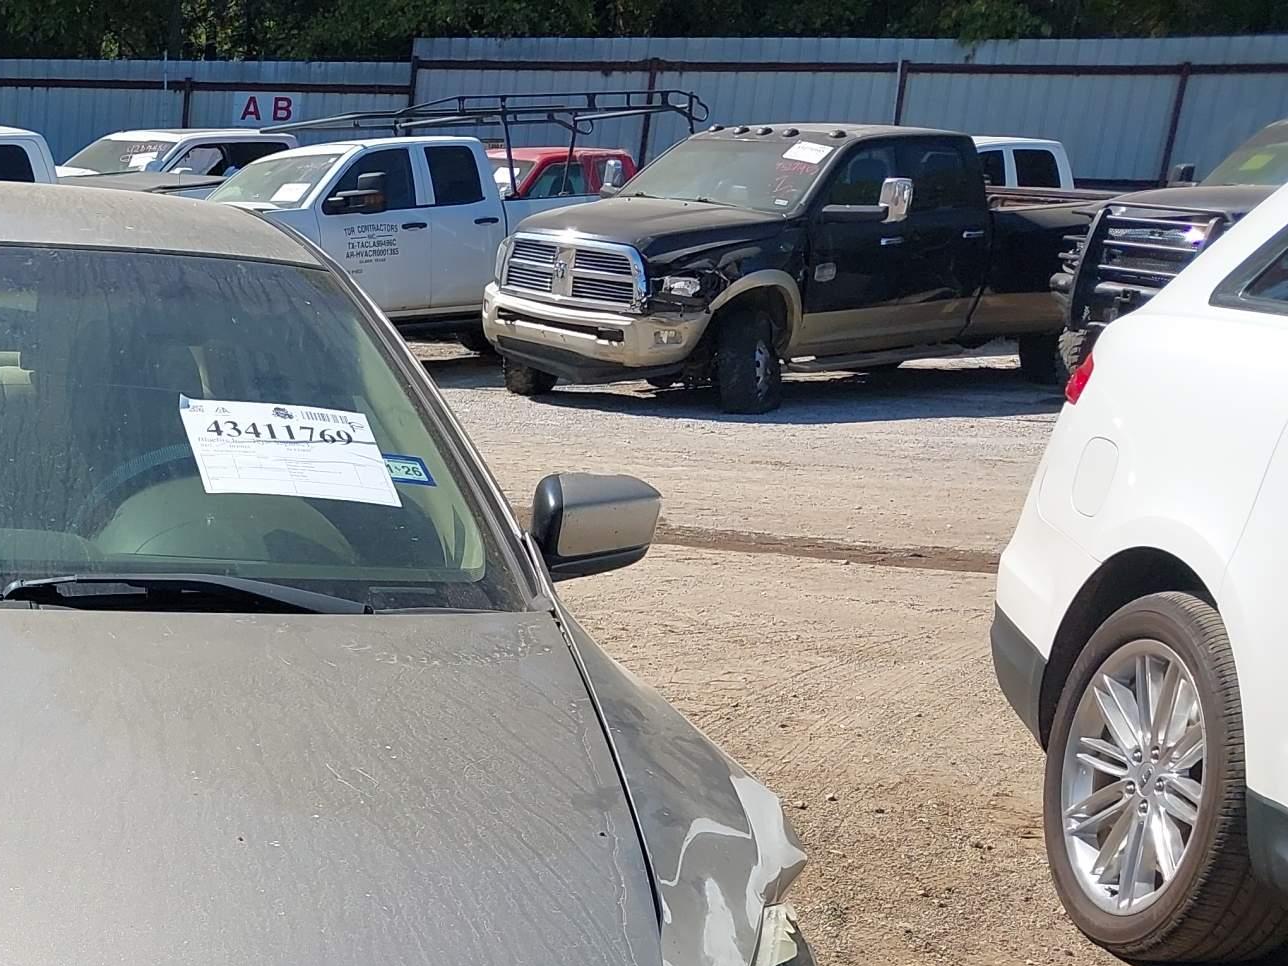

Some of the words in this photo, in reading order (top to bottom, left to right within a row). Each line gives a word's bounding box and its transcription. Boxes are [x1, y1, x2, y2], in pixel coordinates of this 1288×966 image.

[240, 95, 261, 120] A
[272, 96, 292, 121] B
[357, 223, 398, 233] CONTRACTORS
[206, 419, 353, 446] 43411769
